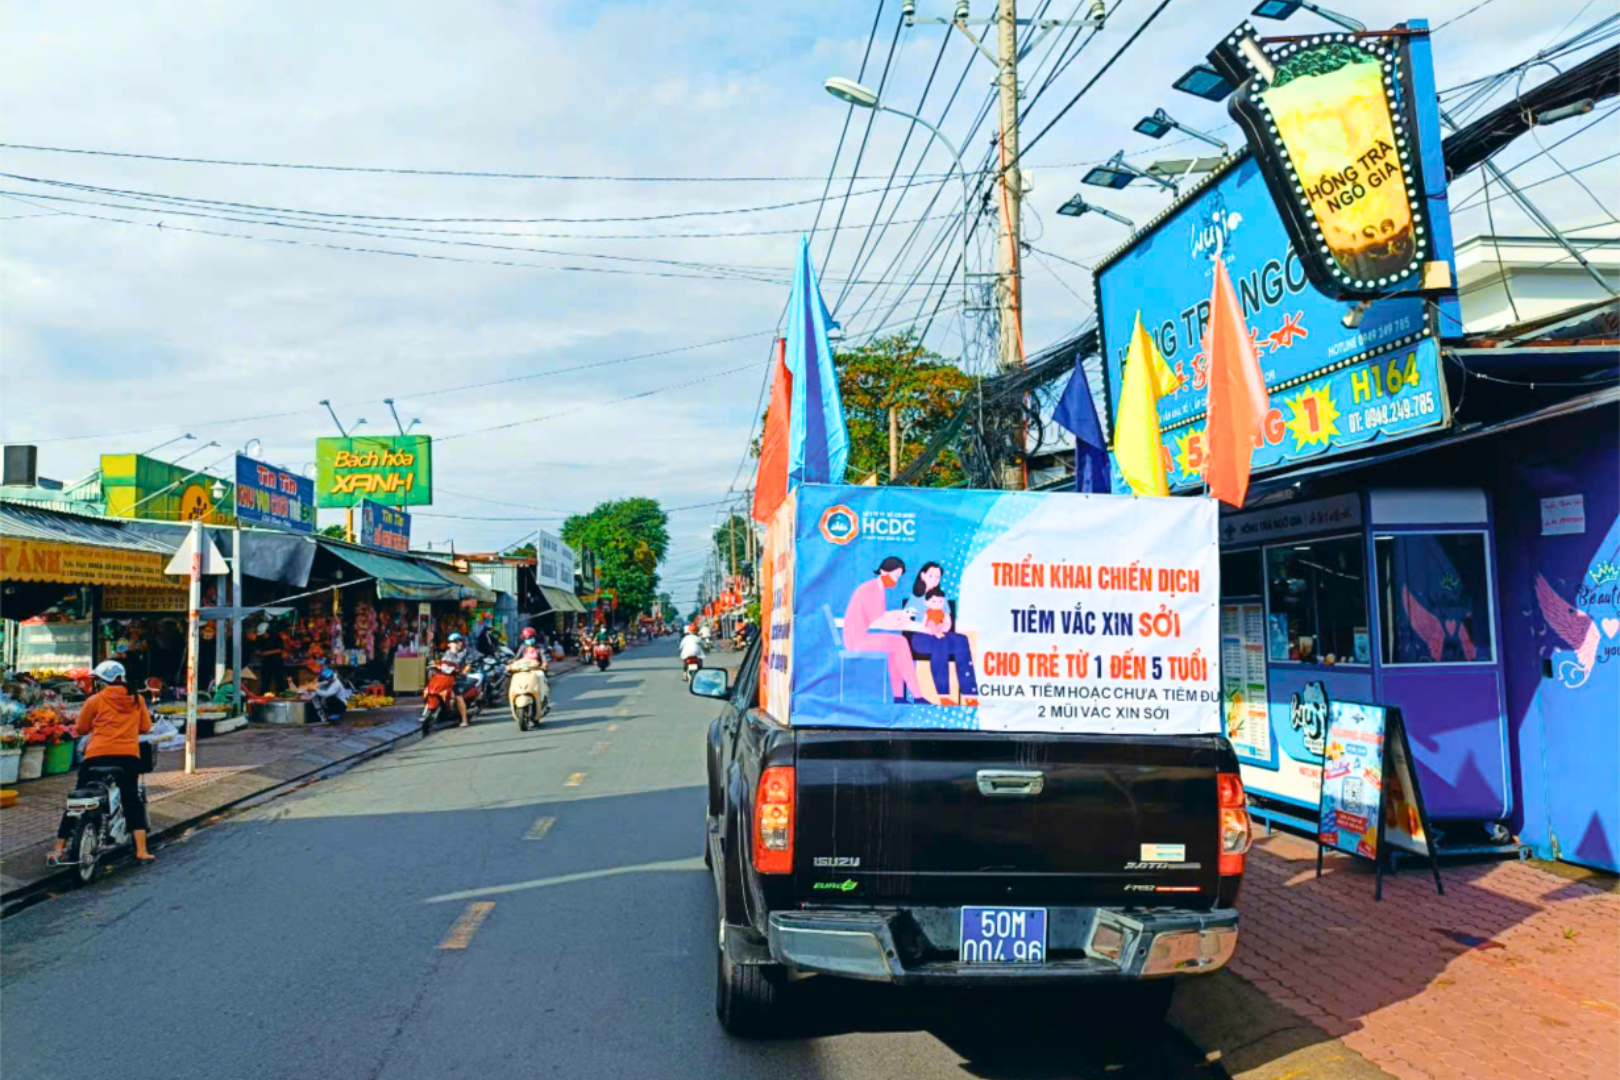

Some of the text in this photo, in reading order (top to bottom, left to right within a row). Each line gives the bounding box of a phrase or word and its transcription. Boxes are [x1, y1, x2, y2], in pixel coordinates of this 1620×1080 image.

[1357, 139, 1394, 171] TRÀ
[1326, 161, 1398, 214] NGÔ GIA
[1181, 300, 1212, 347] TR
[1189, 436, 1203, 469] 5
[1302, 397, 1319, 433] 1
[1351, 352, 1419, 404] H164
[334, 448, 414, 468] Bách hóa
[330, 472, 415, 494] XANH
[862, 519, 916, 536] HCDC
[991, 554, 1200, 597] TRIỂN KHAI CHIẾN DỊCH
[1575, 584, 1620, 608] Beaut
[1011, 604, 1055, 634] TIÊM
[1061, 602, 1096, 635] VẮC
[1139, 604, 1181, 637] SỞI
[983, 645, 1208, 682] CHO TRẺ TỪ 1 ĐẾN 5 TUỔI
[979, 684, 1025, 697] CHƯA
[1114, 686, 1158, 701] CHƯA
[1037, 706, 1046, 718] 2
[1050, 703, 1078, 719] MŨI
[1116, 707, 1140, 719] XIN
[813, 857, 860, 867] ISUZU
[981, 911, 1026, 938] 50M
